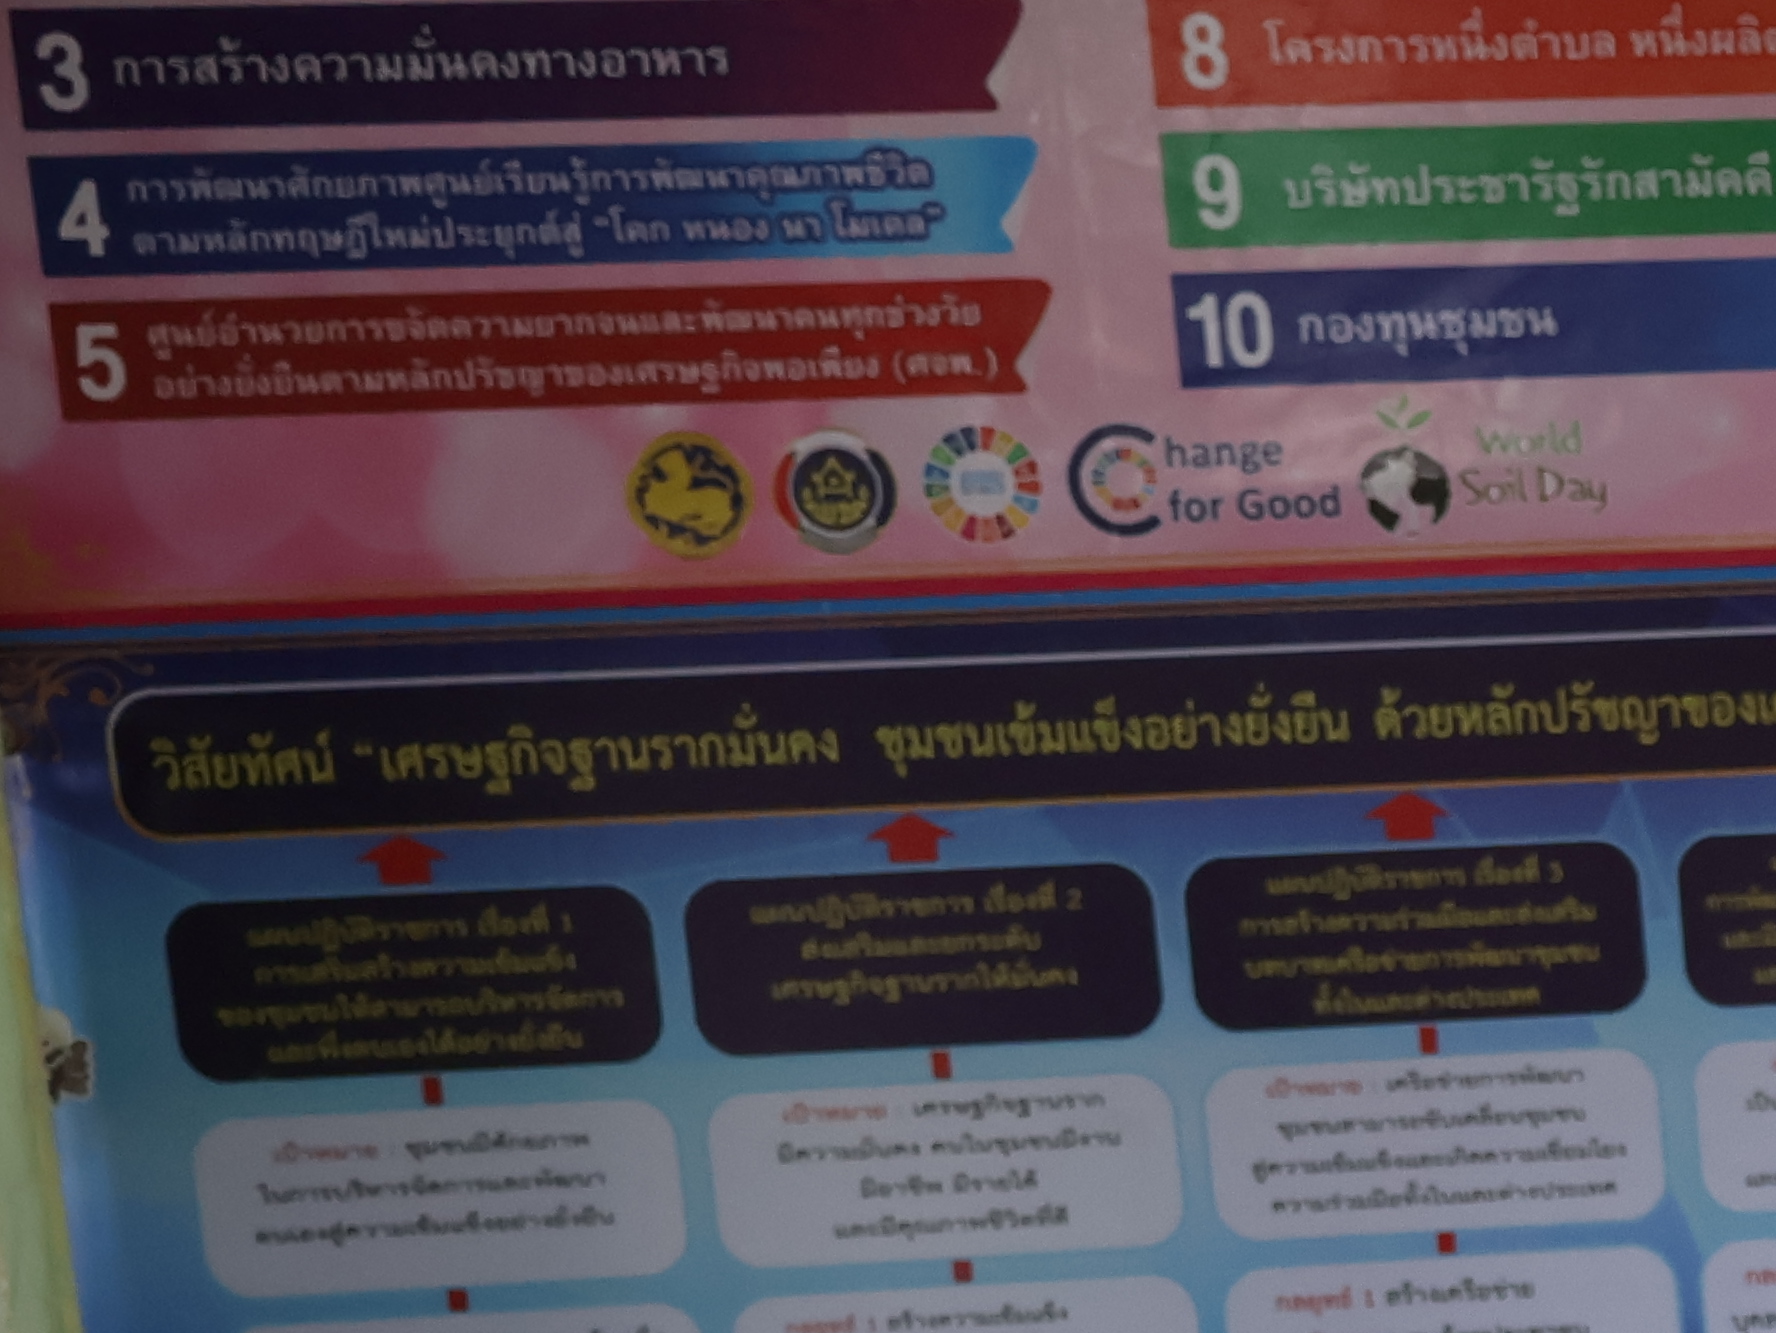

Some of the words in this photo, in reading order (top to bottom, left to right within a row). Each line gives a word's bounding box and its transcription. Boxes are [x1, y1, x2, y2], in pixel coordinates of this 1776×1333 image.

[37, 29, 90, 114] 3
[114, 23, 731, 88] การสร้างความมั่นคงทางอาหาร
[1179, 12, 1229, 90] 8
[57, 178, 112, 257] 4
[1194, 154, 1242, 231] 9
[76, 322, 126, 401] 5
[1184, 289, 1276, 368] 10
[1297, 300, 1559, 356] กองทุนชุมชน
[1476, 420, 1583, 456] World
[1168, 487, 1224, 523] for
[1238, 485, 1343, 523] Good
[1458, 466, 1528, 507] Soil
[1538, 468, 1609, 515] Day
[150, 728, 335, 793] วิสัยทัศน์
